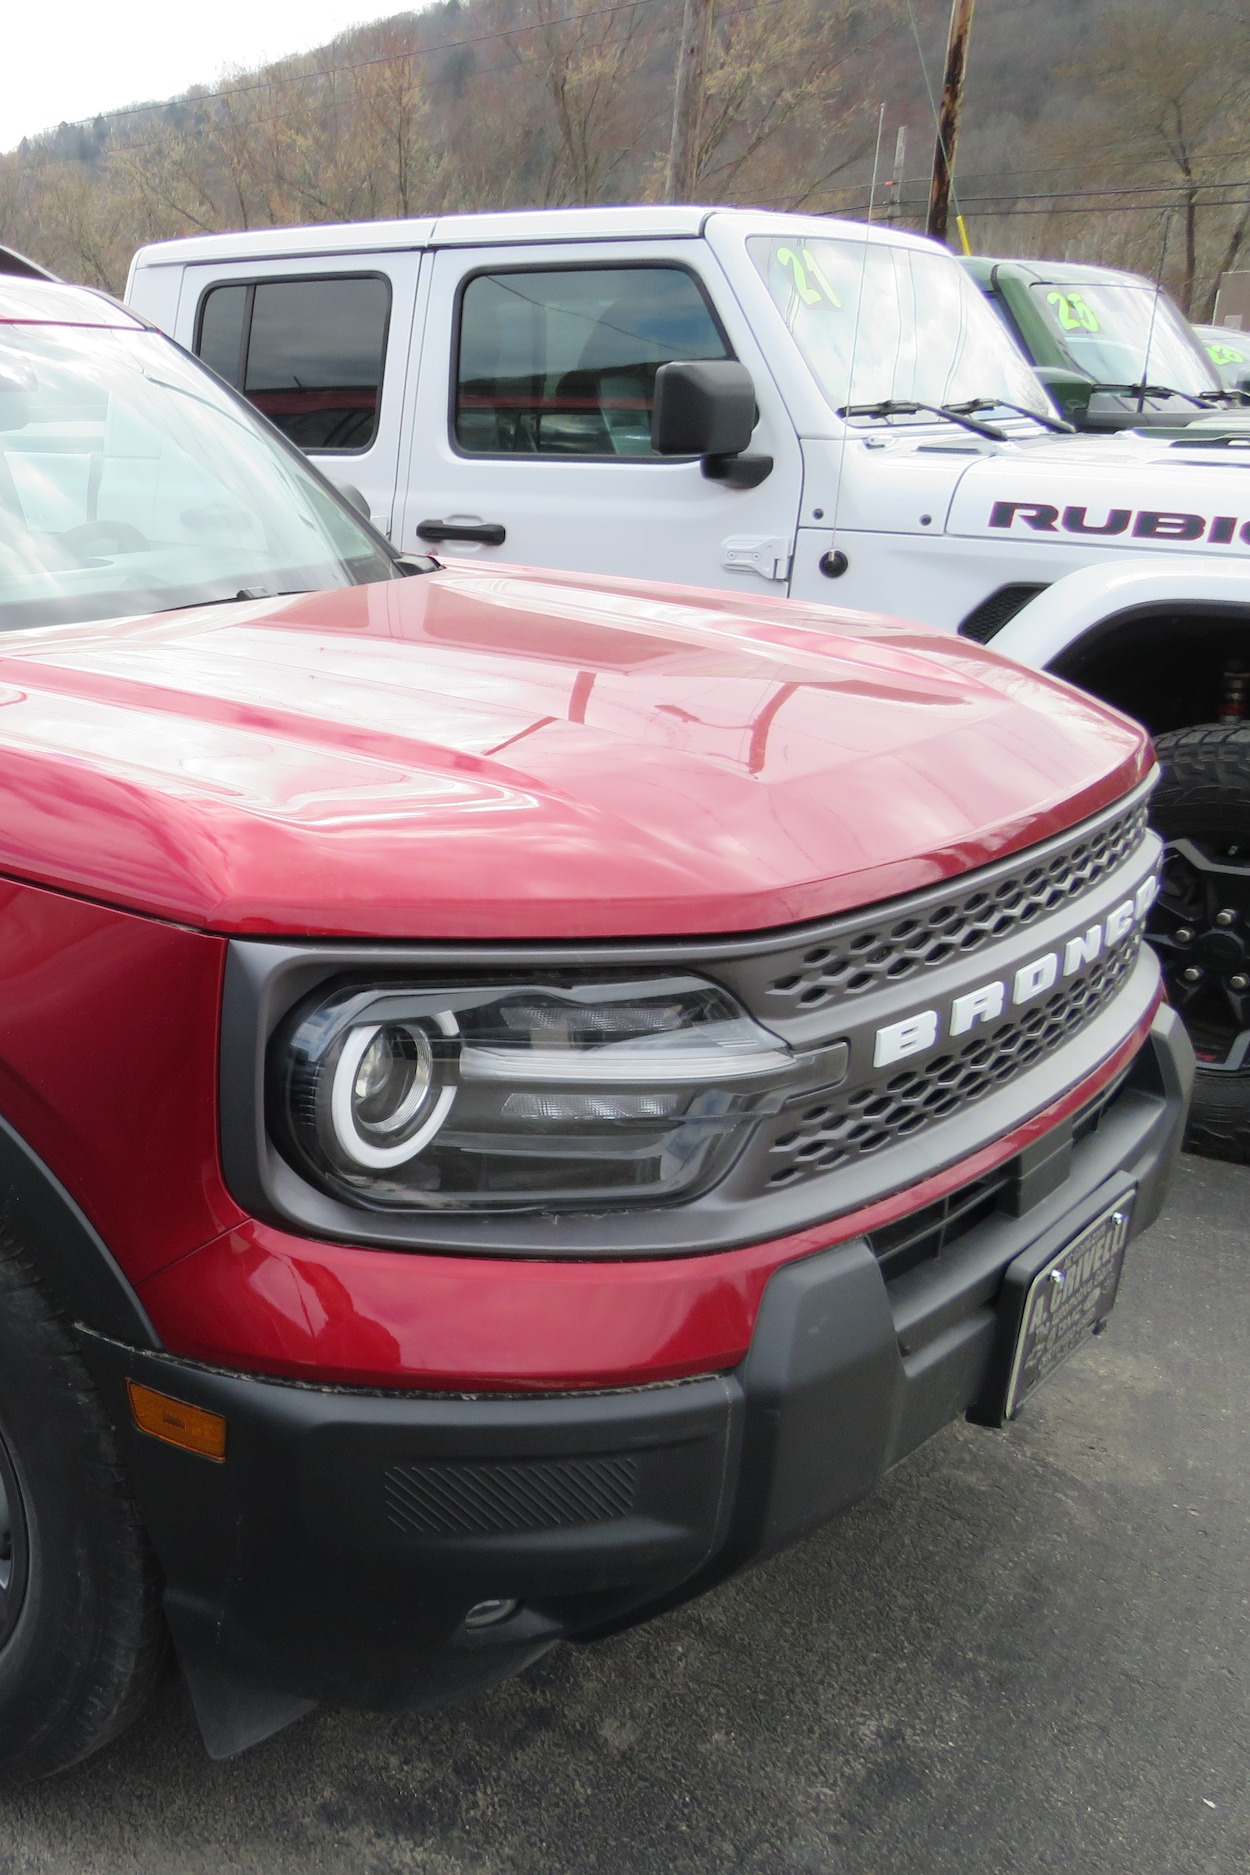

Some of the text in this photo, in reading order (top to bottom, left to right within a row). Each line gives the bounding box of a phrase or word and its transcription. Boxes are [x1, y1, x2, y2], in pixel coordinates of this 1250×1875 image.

[776, 247, 843, 308] 21
[987, 500, 1250, 546] RUBI
[873, 875, 1157, 1069] BRONCO
